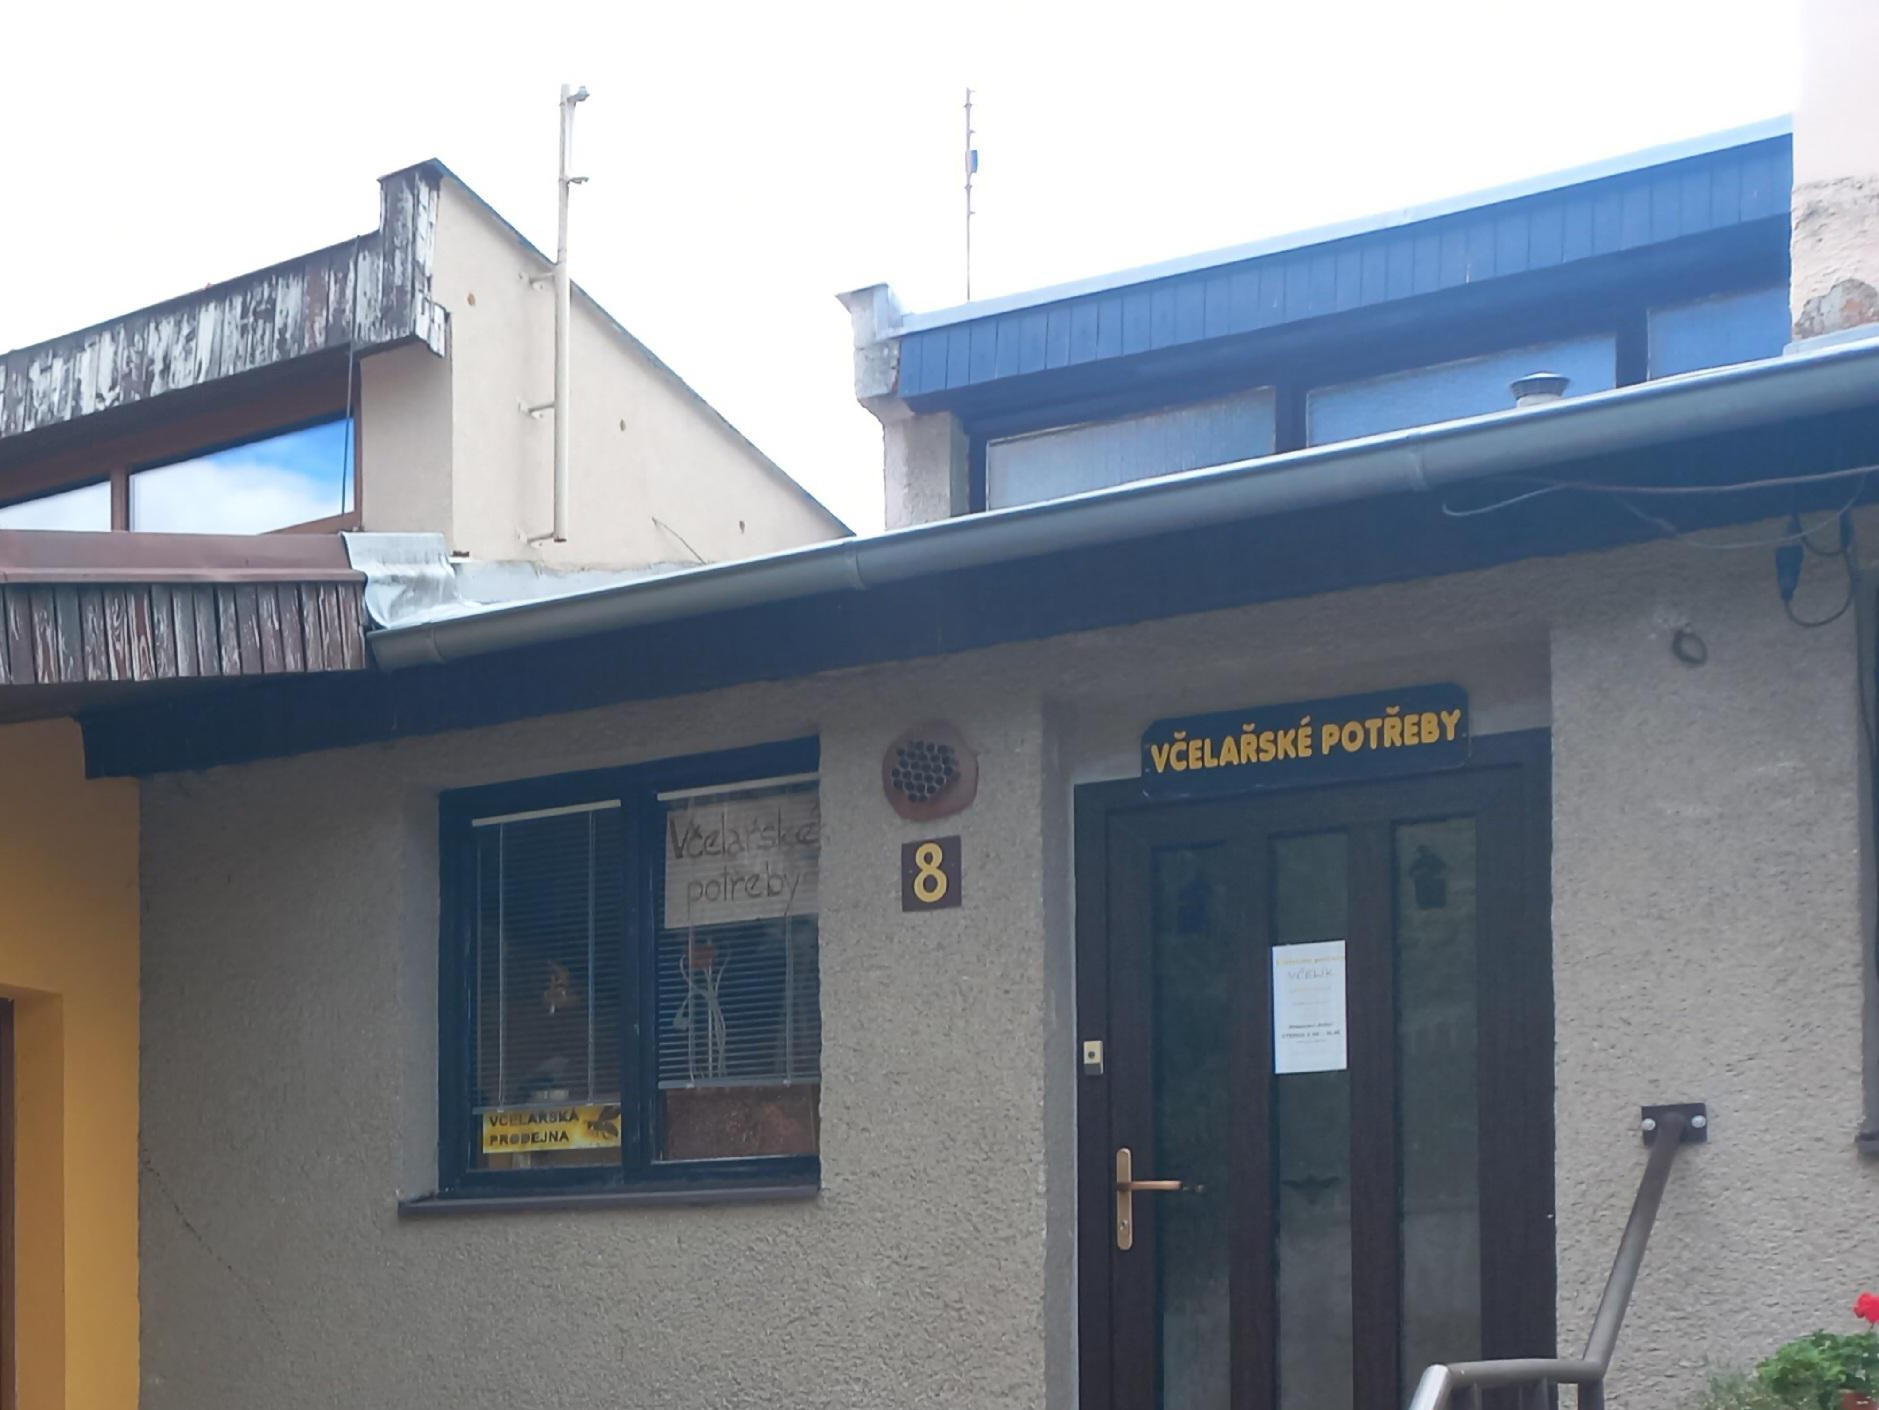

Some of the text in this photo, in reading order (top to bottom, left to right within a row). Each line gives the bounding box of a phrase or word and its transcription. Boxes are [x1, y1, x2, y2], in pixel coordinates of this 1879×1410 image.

[1150, 705, 1462, 773] VČELAŘSKÉ POTŘEBY
[913, 841, 949, 903] 8
[489, 1130, 570, 1146] PRODEJNA
